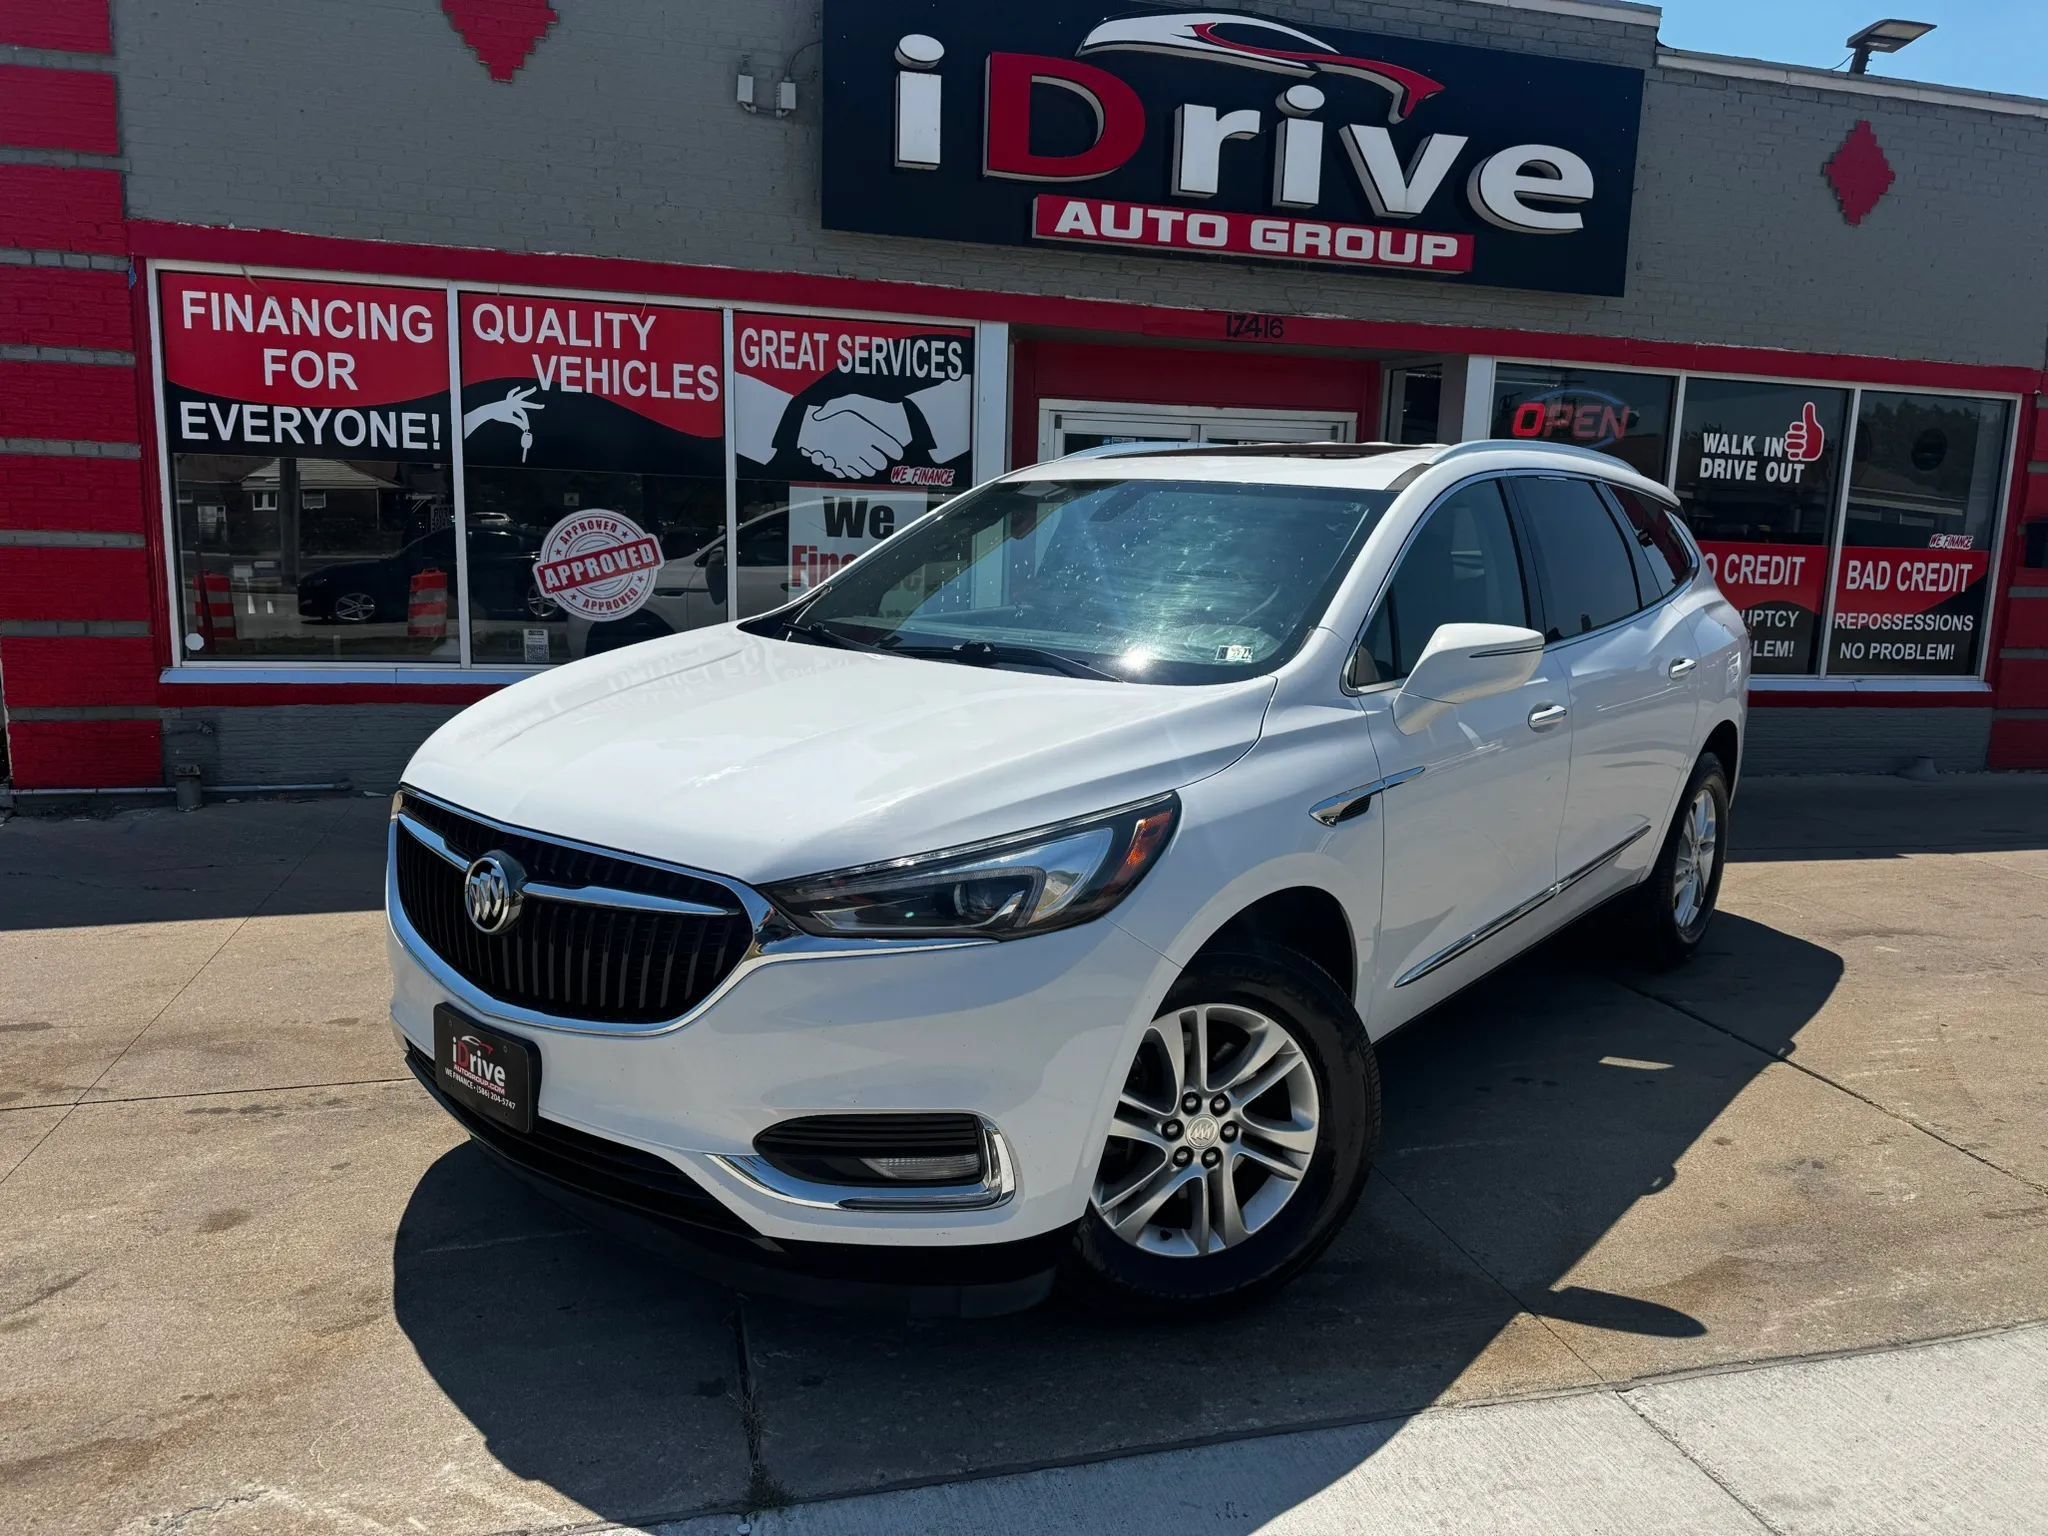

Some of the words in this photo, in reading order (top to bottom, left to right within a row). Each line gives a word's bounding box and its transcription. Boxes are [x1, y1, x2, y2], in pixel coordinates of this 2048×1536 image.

[1054, 201, 1229, 247] AUTO
[1249, 221, 1459, 265] GROUP
[181, 289, 433, 344] FINANCING
[471, 302, 656, 351] QUALITY
[1226, 313, 1285, 339] 17416
[262, 347, 359, 392] FOR
[740, 328, 829, 371] GREAT
[836, 333, 963, 380] SERVICES
[531, 354, 719, 401] VEHICLES
[179, 401, 441, 450] EVERYONE!
[1512, 402, 1631, 438] OPEN
[1703, 432, 1756, 456] WALK
[1763, 436, 1785, 458] IN
[891, 466, 909, 482] WE
[911, 467, 955, 486] FINANCE
[1699, 457, 1758, 481] DRIVE
[1765, 461, 1805, 484] OUT
[558, 519, 619, 546] APPROVED
[822, 496, 895, 540] We
[1929, 533, 1944, 548] WE
[1944, 534, 1974, 550] FINANCE
[544, 542, 656, 589] APPROVED
[1724, 553, 1806, 586] CREDIT
[1845, 560, 1891, 591] BAD
[1896, 561, 1973, 593] CREDIT
[582, 587, 639, 612] APPROVED
[1834, 612, 1974, 632] REPOSSESSIONS
[1839, 642, 1865, 660] NO
[1869, 642, 1955, 661] PROBLEM!
[452, 1036, 506, 1087] iDrive
[445, 1067, 453, 1078] WE
[452, 1071, 474, 1090] FINANCE
[453, 1064, 506, 1096] AUTOGROUP.COM
